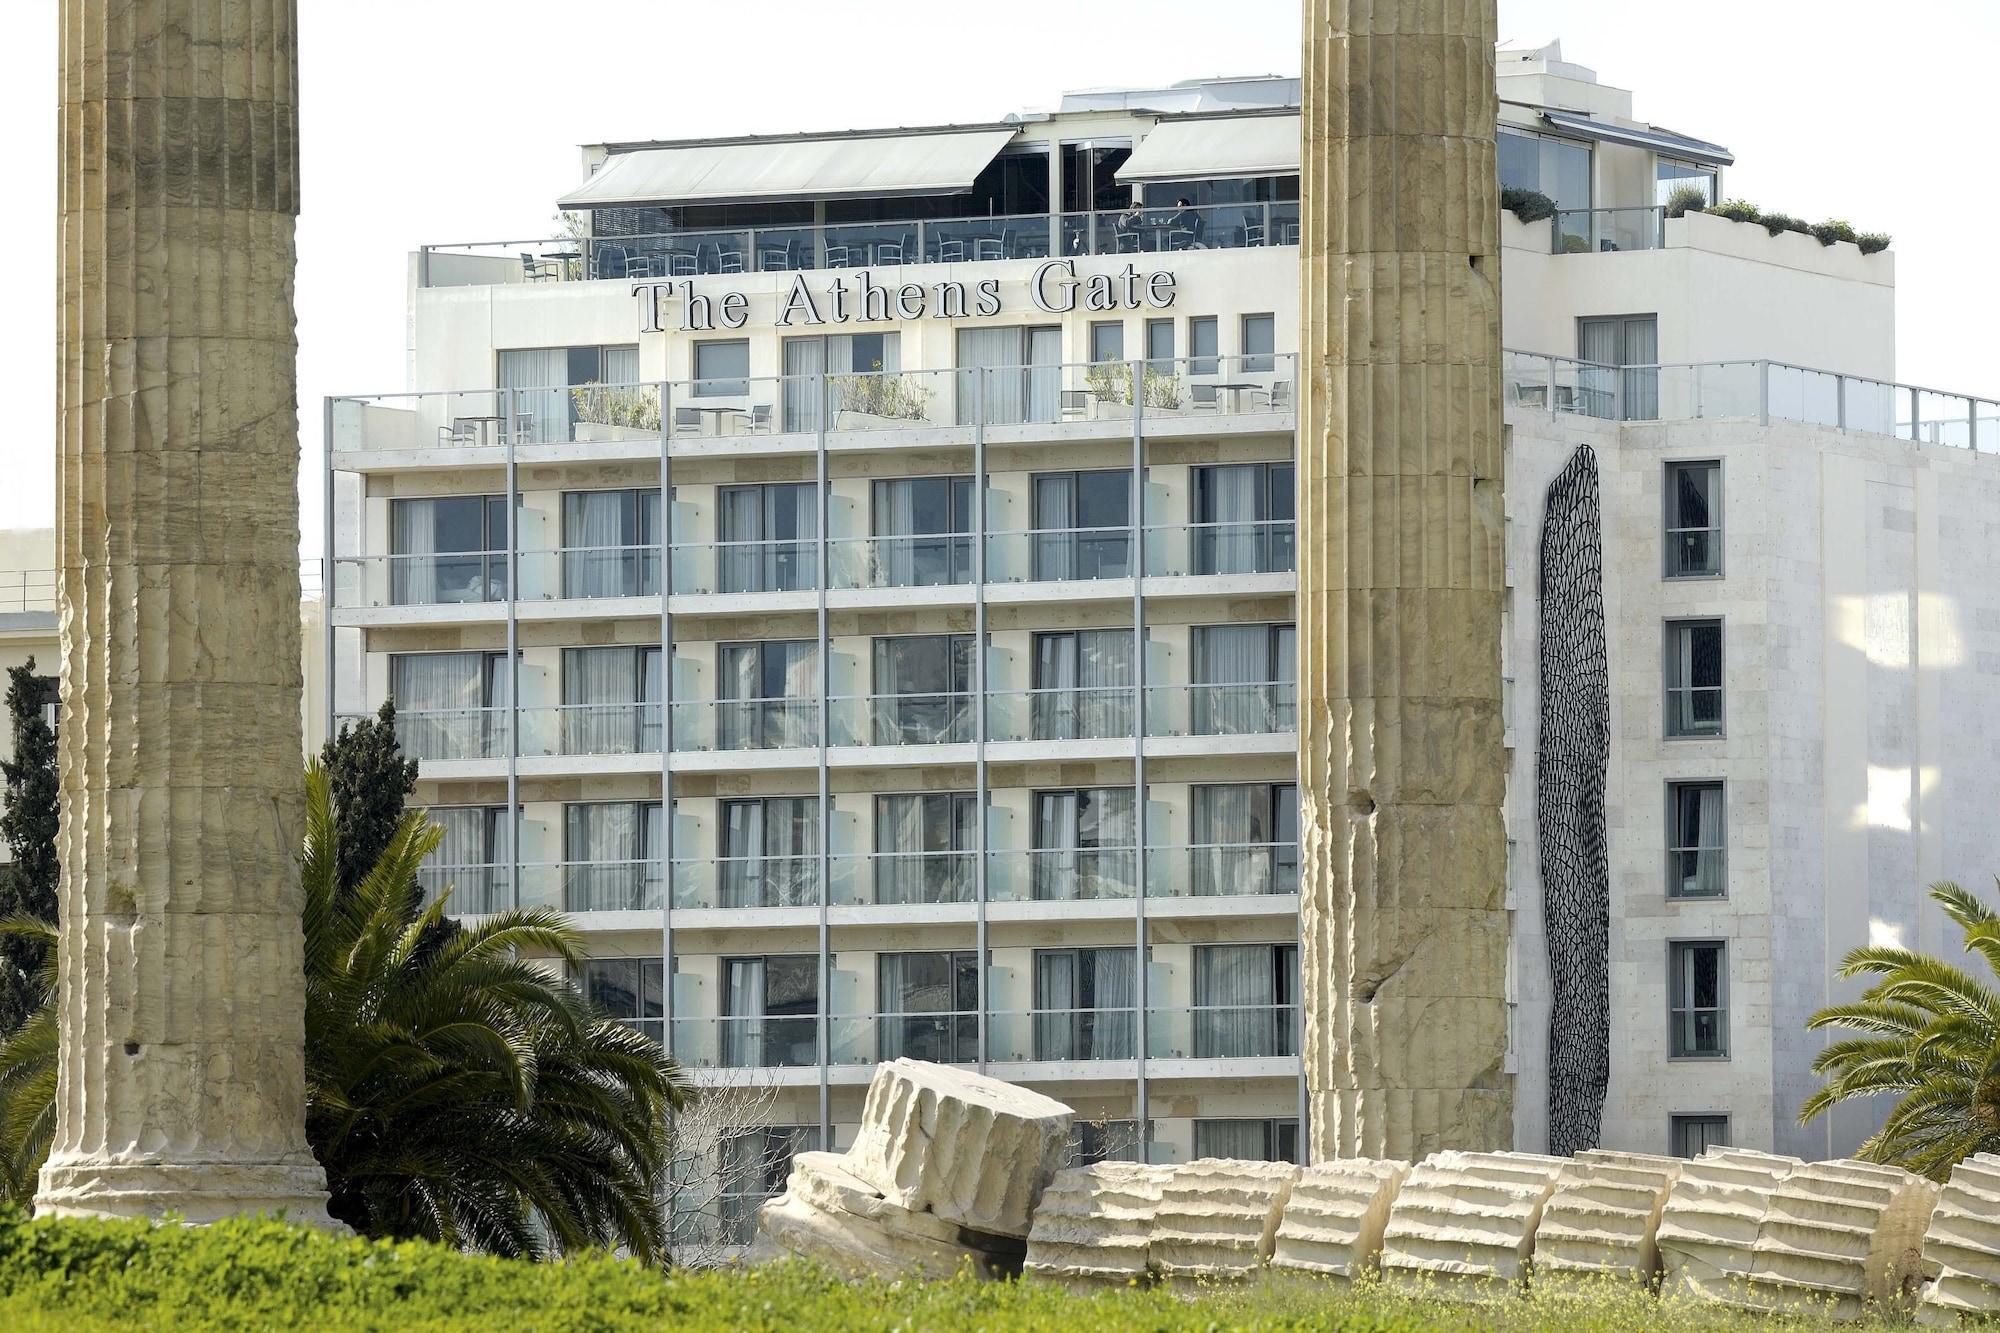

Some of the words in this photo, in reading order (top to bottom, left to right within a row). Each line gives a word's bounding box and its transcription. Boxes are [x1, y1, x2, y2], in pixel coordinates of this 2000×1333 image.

[632, 280, 749, 333] The
[775, 267, 1001, 327] Athens
[1030, 259, 1176, 314] Gate
